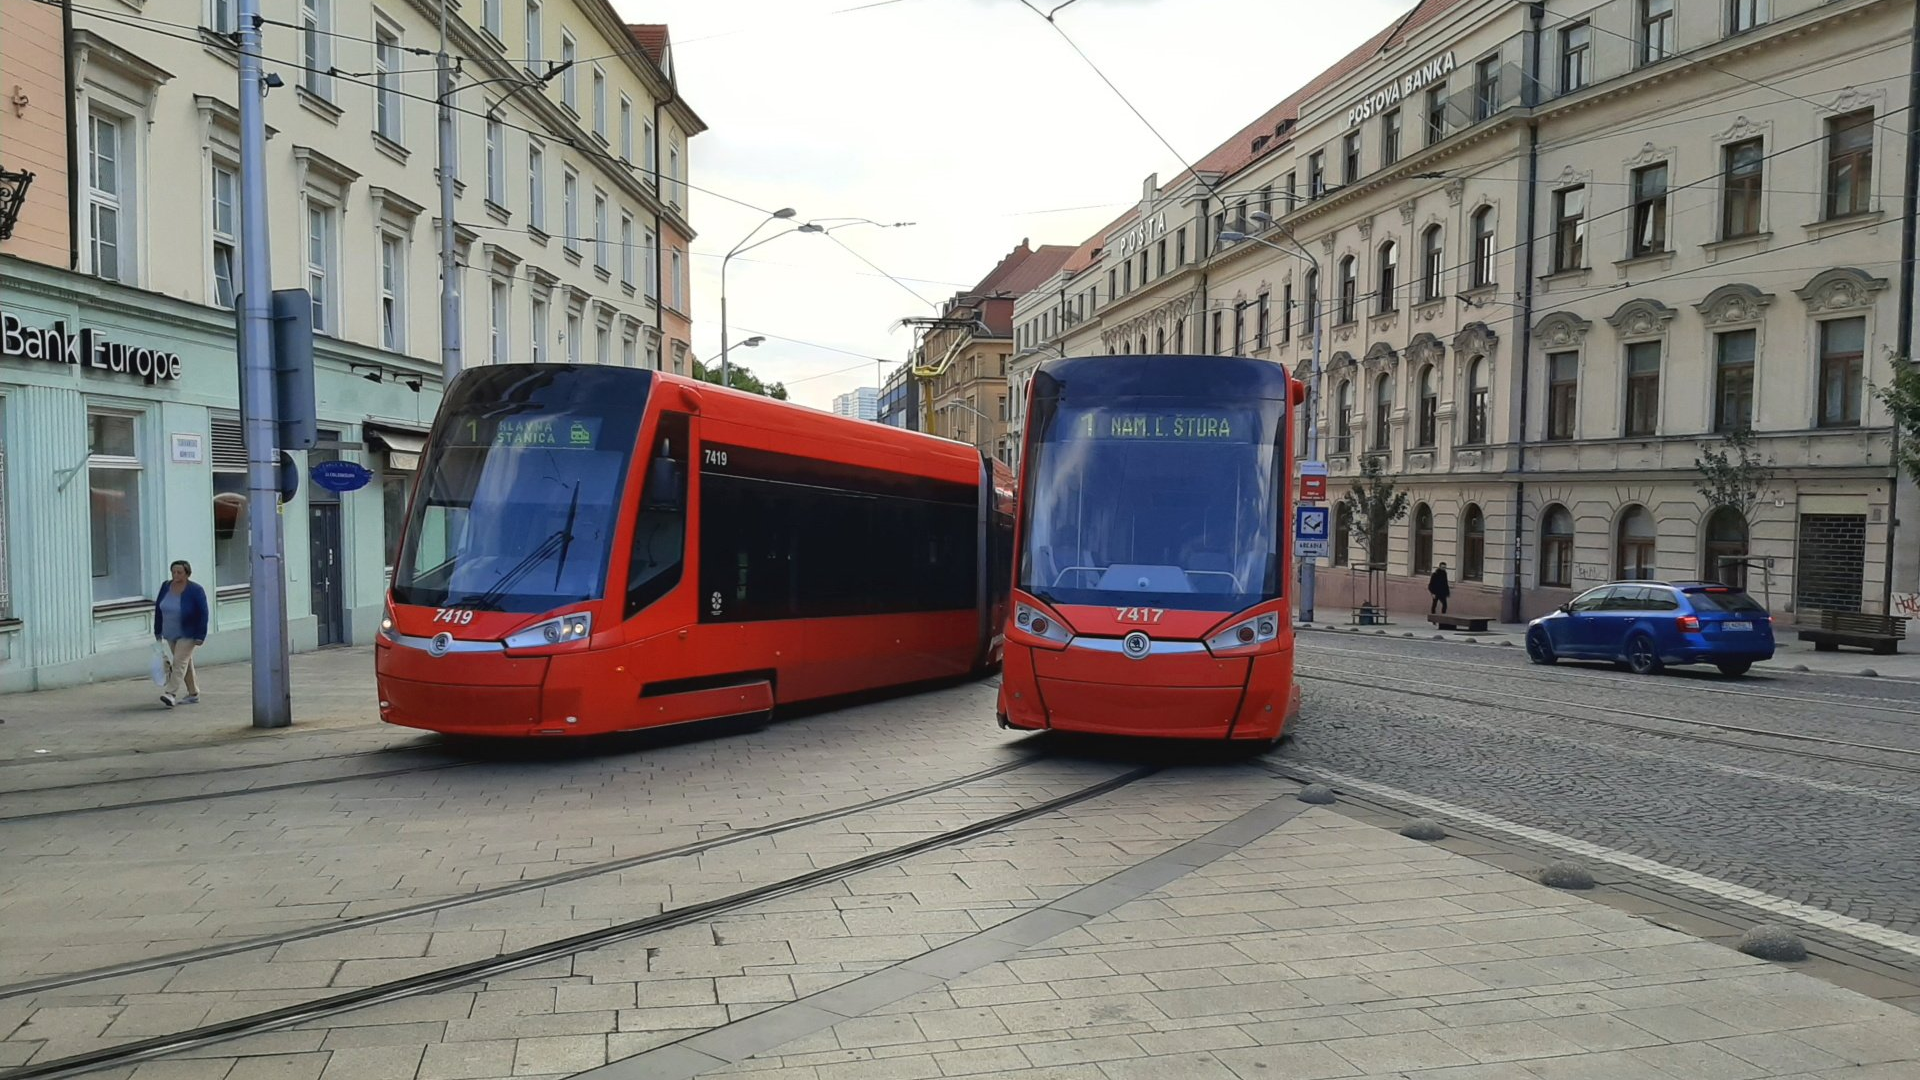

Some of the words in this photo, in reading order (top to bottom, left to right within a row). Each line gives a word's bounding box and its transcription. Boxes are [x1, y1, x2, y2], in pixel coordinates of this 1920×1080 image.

[1405, 50, 1455, 96] BANKA
[1120, 211, 1165, 256] POŠTA
[1, 311, 81, 364] Bank
[86, 328, 182, 385] Europe
[466, 420, 477, 442] 1
[1081, 413, 1096, 437] 1
[497, 432, 555, 443] STANICA
[705, 449, 727, 465] 7419
[433, 608, 473, 624] 7419
[1116, 607, 1164, 622] 7417
